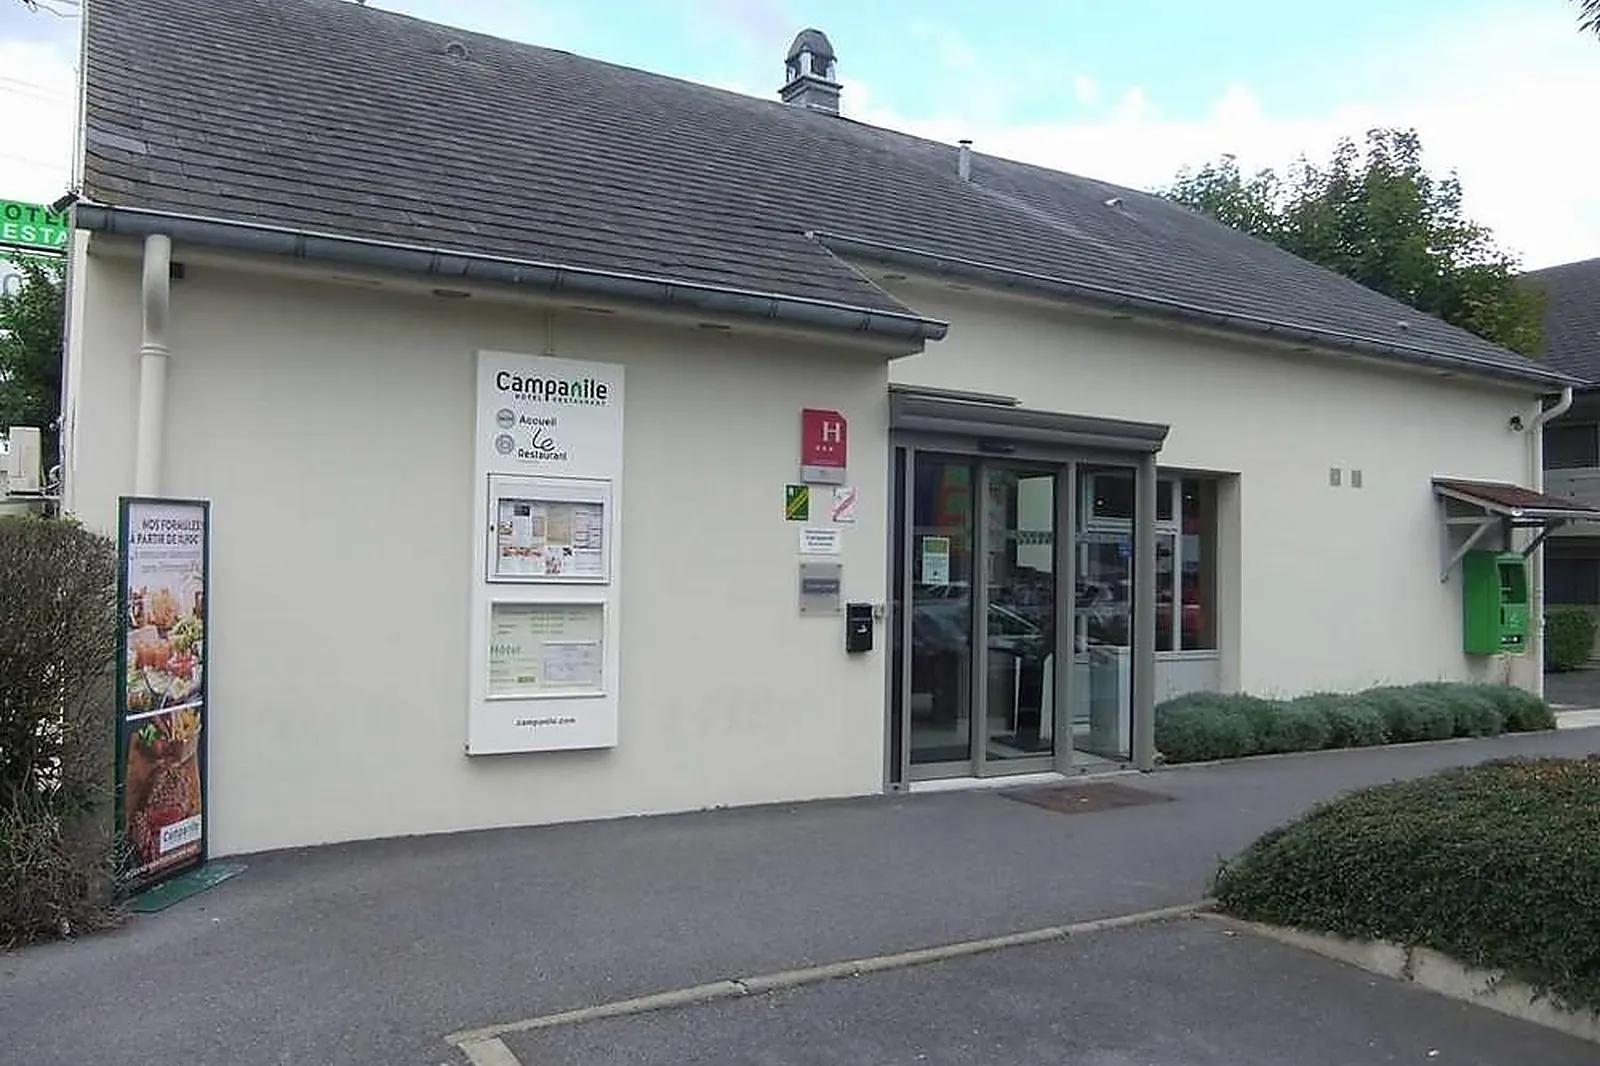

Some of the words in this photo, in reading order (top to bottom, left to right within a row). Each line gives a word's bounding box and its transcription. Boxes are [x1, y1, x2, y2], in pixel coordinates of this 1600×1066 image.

[496, 371, 607, 402] Campanile
[519, 415, 557, 427] Accueil
[822, 421, 841, 443] H
[532, 428, 555, 452] Le
[517, 448, 567, 460] Restaurant
